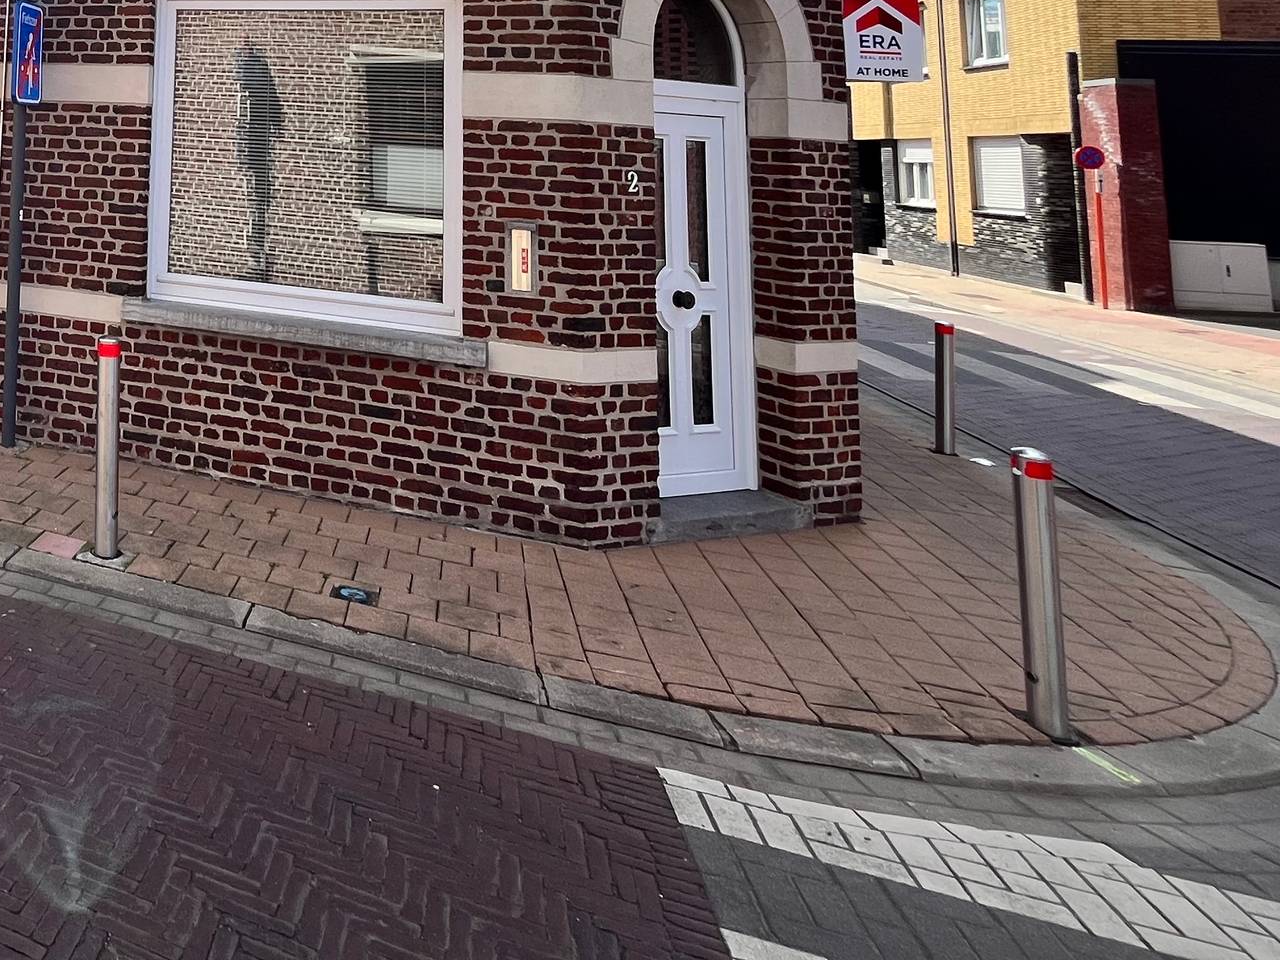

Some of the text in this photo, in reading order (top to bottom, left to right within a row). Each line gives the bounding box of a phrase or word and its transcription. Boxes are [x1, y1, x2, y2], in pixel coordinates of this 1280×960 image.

[859, 34, 902, 50] ERA
[856, 67, 909, 77] AT HOME
[627, 171, 639, 192] 2
